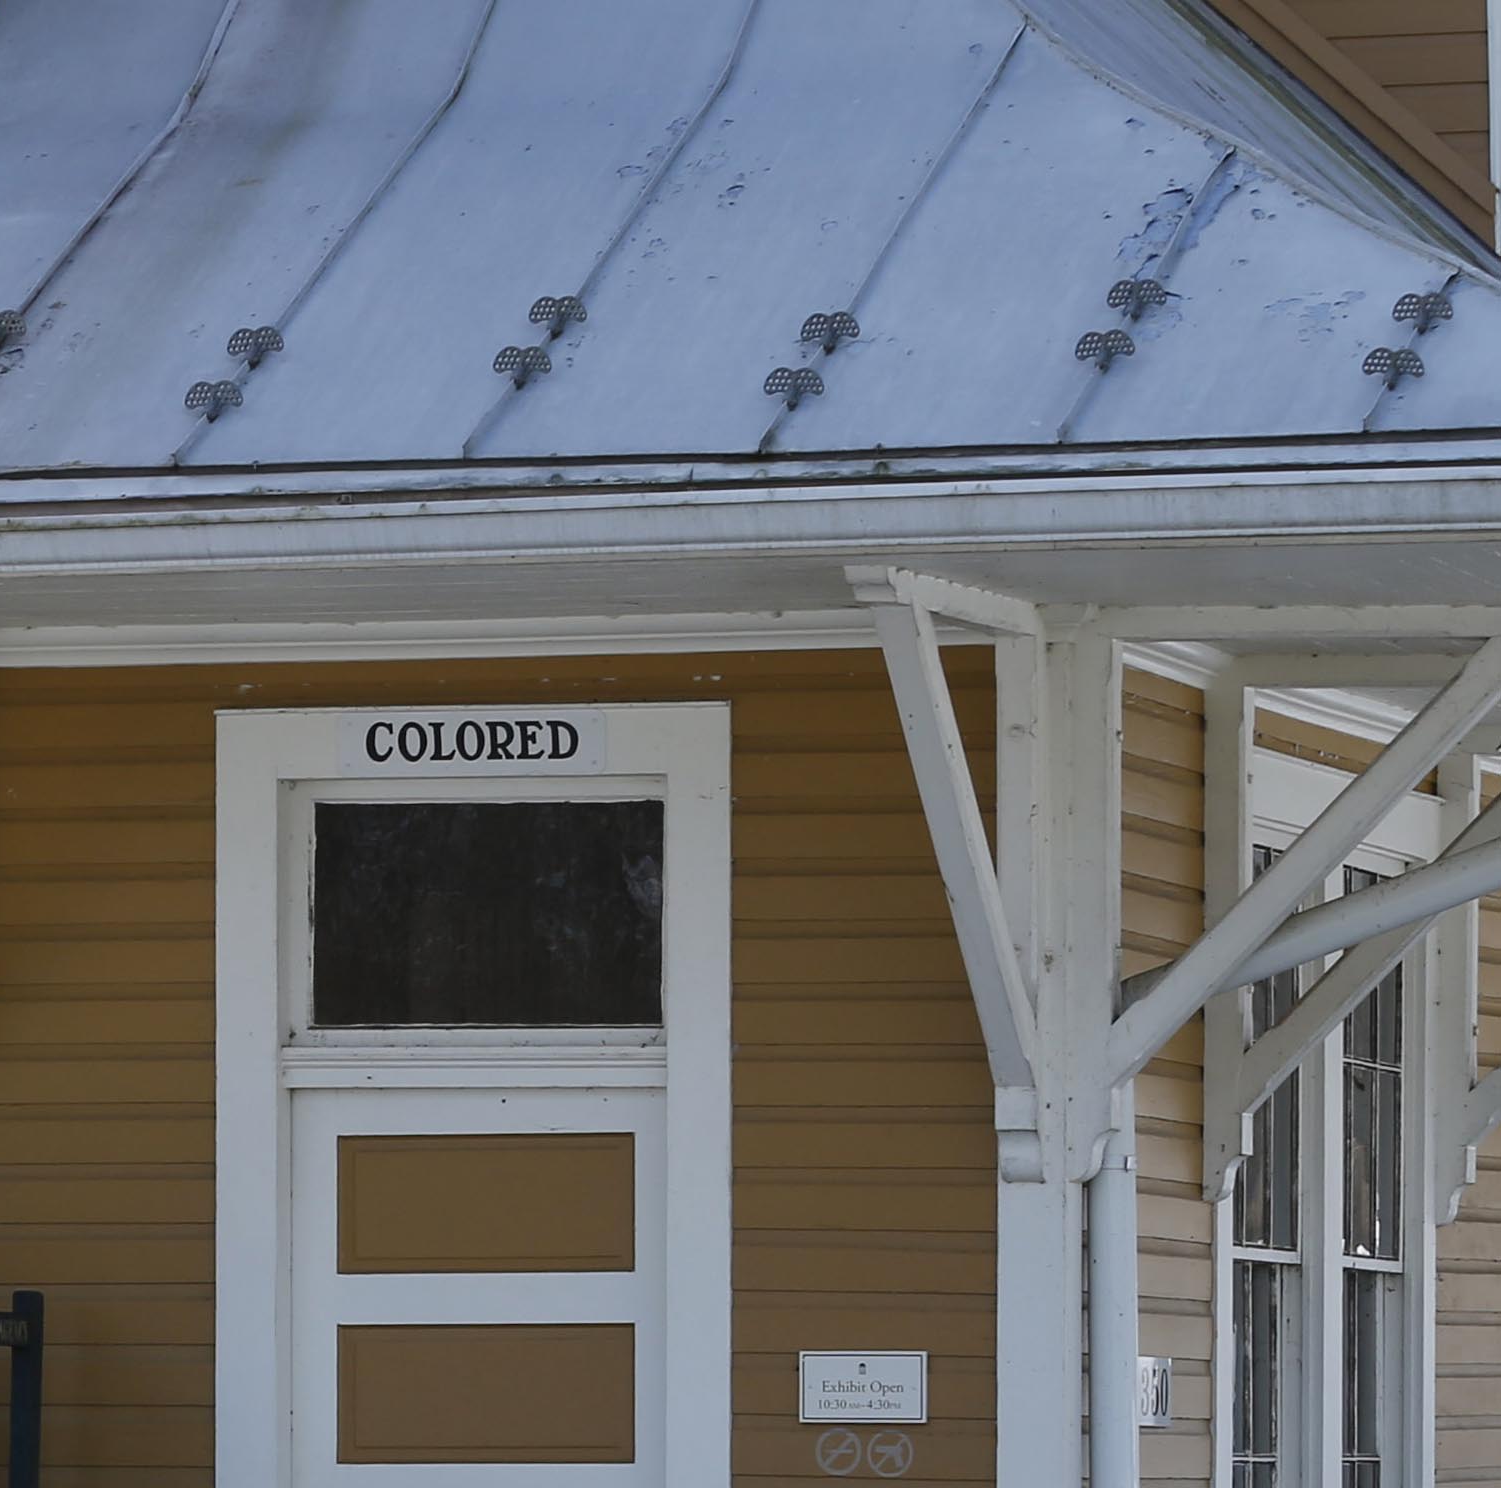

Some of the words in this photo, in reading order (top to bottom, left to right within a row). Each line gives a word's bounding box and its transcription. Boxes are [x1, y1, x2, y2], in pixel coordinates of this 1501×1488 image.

[366, 720, 578, 762] COLORED
[822, 1380, 866, 1393] Exhibit
[870, 1380, 904, 1397] Open
[1142, 1368, 1168, 1416] 350
